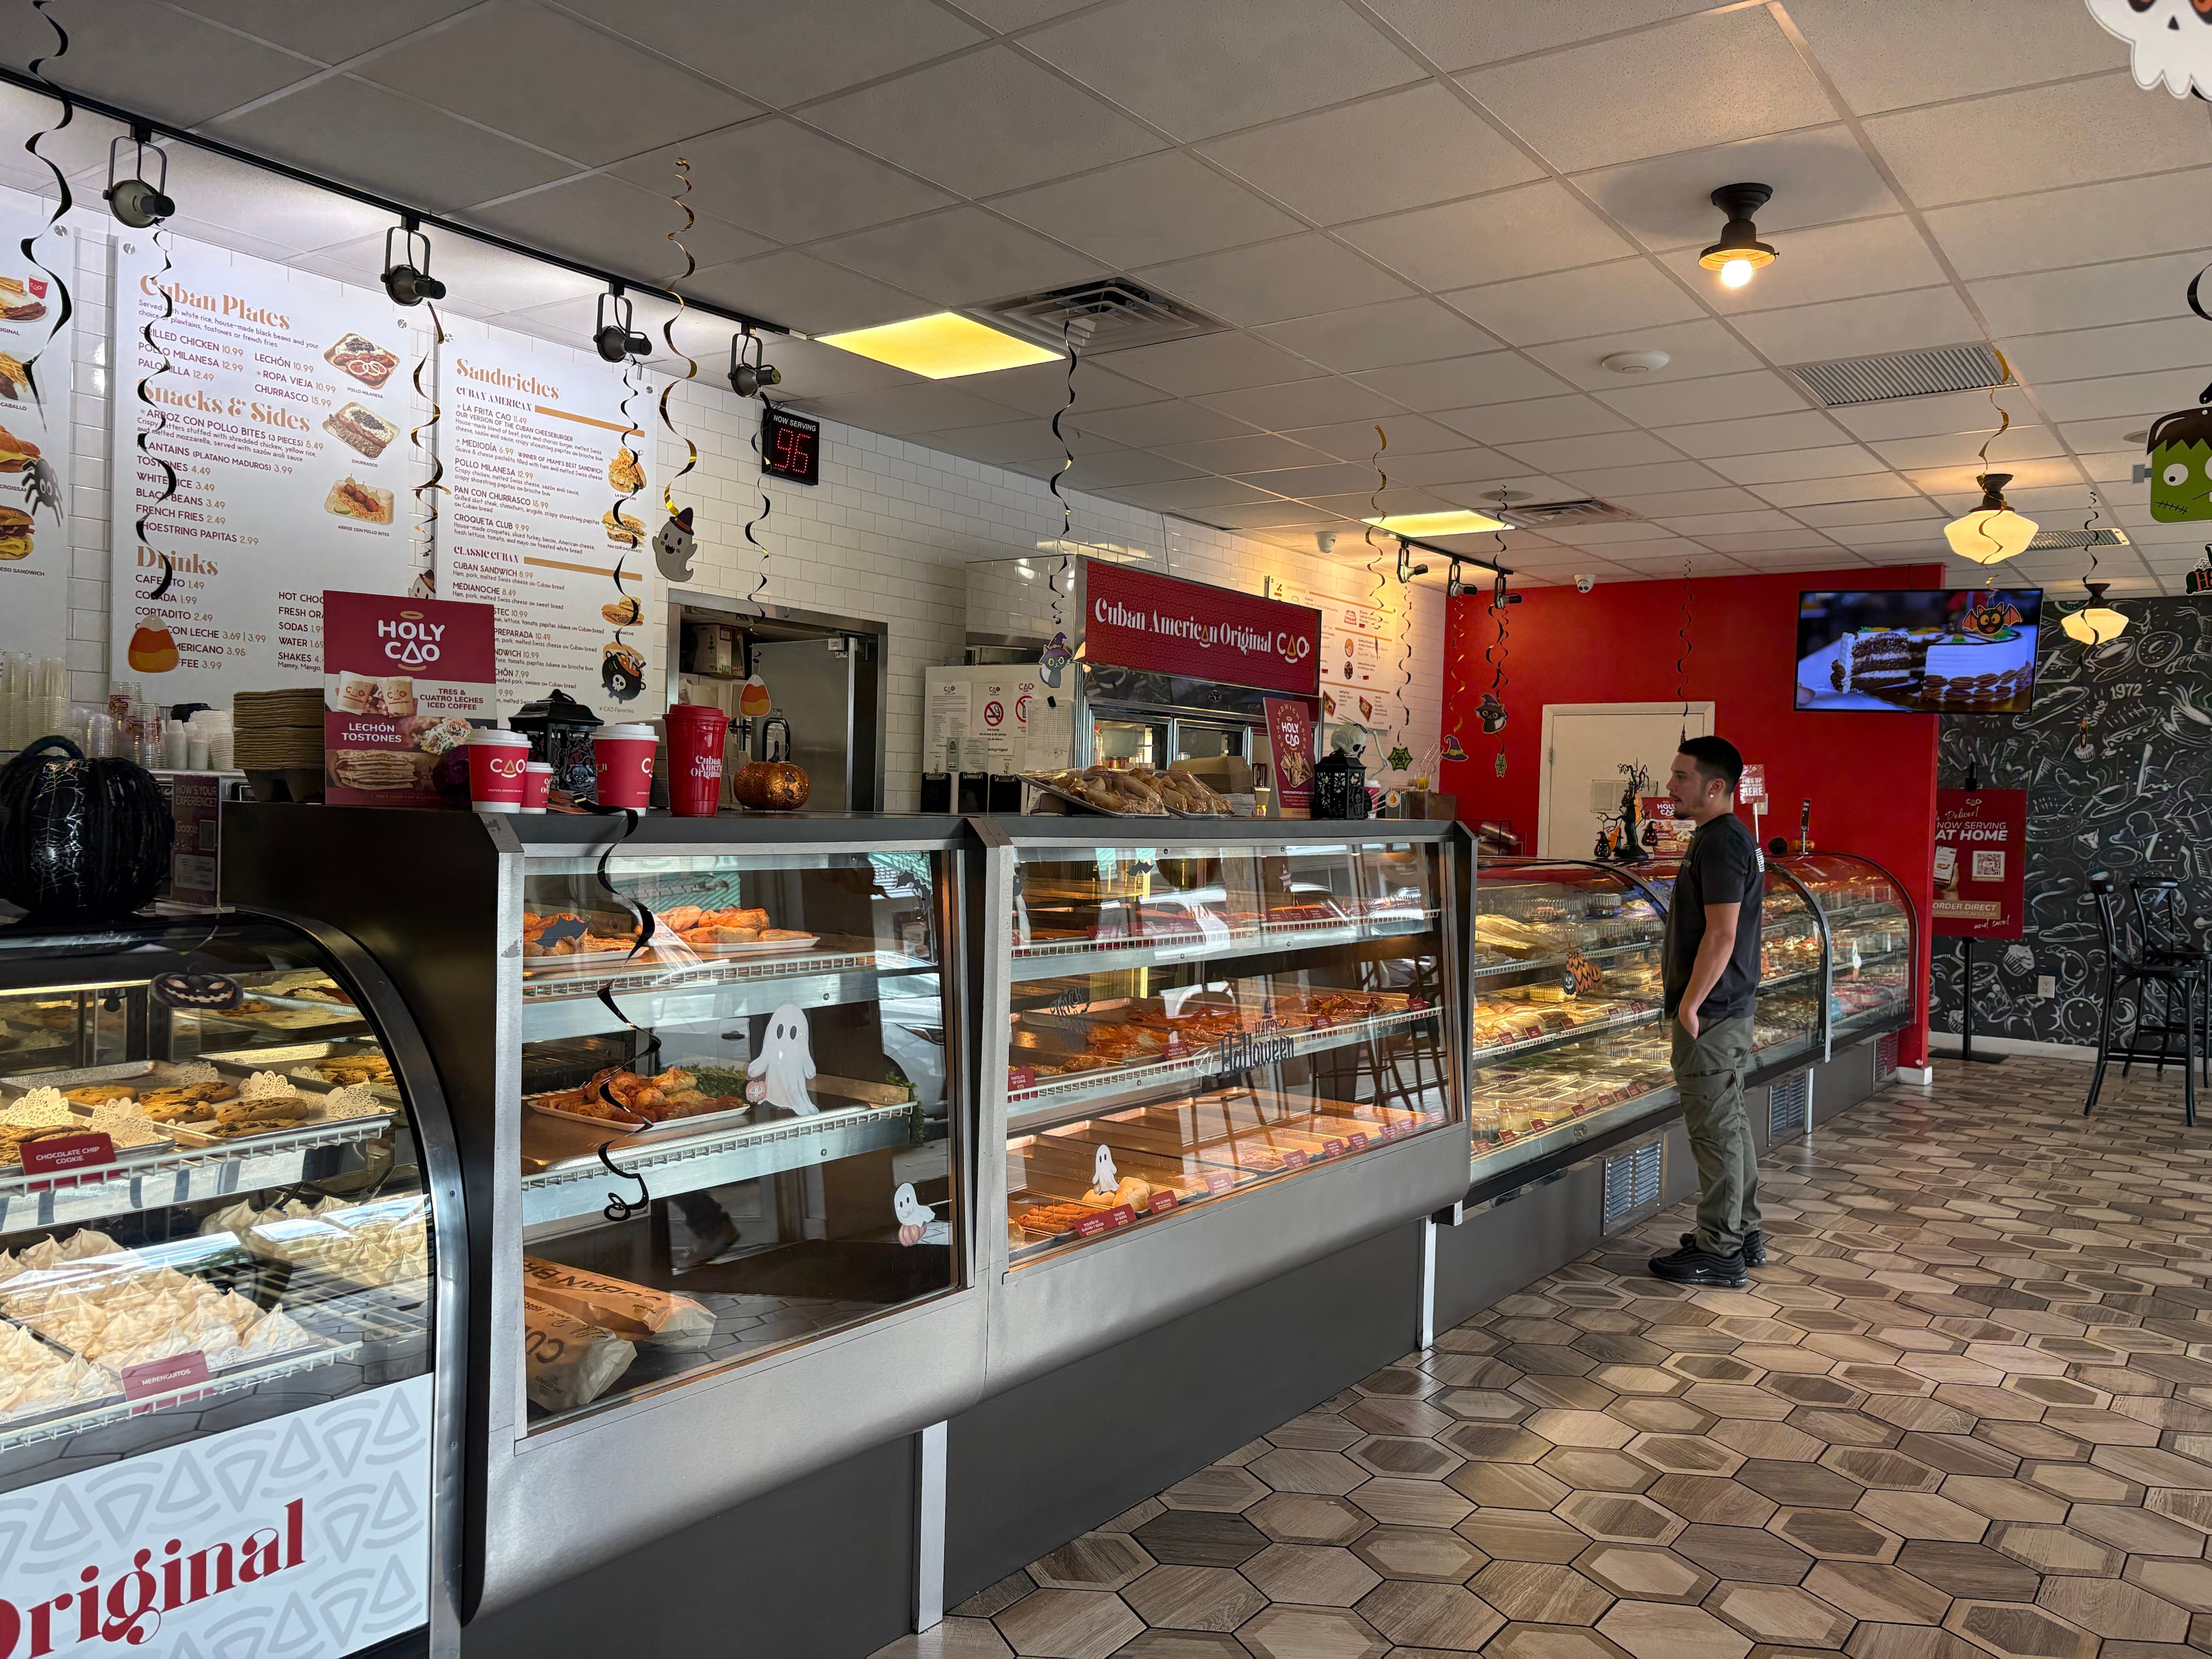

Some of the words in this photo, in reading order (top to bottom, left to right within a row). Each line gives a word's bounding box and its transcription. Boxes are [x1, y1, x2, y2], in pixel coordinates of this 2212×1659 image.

[140, 275, 216, 312] Cuban
[222, 294, 290, 330] Plates
[139, 300, 162, 311] Served
[181, 310, 199, 319] white
[256, 328, 272, 338] black
[274, 333, 291, 342] beans
[139, 310, 159, 319] choice
[243, 334, 262, 344] french
[264, 339, 278, 347] fries
[180, 336, 219, 351] CHICKEN
[222, 345, 243, 357] 10.99
[173, 350, 219, 368] MILANESA
[222, 361, 243, 372] 12.99
[255, 353, 290, 368] LECHÓN
[294, 362, 314, 373] 10.99
[193, 370, 214, 381] 12.49
[263, 370, 287, 383] ROPA
[290, 376, 313, 389] VIEJA
[316, 382, 336, 393] 10.99
[457, 358, 559, 400] Sandwiches
[255, 384, 308, 402] CHURRASCO
[311, 396, 331, 407] 15.99
[456, 386, 486, 401] CUBAN
[488, 395, 532, 412] AMERICAN
[1, 402, 27, 411] CABALLO
[463, 403, 472, 412] LA
[474, 407, 493, 418] FRITA
[496, 412, 511, 421] CAO
[514, 415, 527, 425] 11.49
[251, 402, 310, 432] Sides
[470, 414, 493, 424] VERSION
[515, 424, 533, 433] CUBAN
[773, 415, 789, 425] NOW
[789, 419, 816, 432] SERVING
[137, 417, 158, 427] Crispy
[229, 436, 258, 446] shredded
[183, 416, 204, 428] CON
[207, 421, 238, 434] POLLO
[241, 428, 266, 439] BITES
[278, 436, 303, 447] PIECES)
[306, 440, 324, 451] 5.49
[214, 440, 235, 449] served
[775, 428, 810, 473] 96
[352, 459, 378, 468] CHURRASCO
[462, 438, 497, 452] MEDIODÍA
[499, 447, 514, 455] 6.99
[578, 464, 603, 475] SANDWICH
[192, 465, 211, 475] 4.49
[274, 464, 292, 474] 3.99
[455, 458, 479, 469] POLLO
[481, 463, 515, 476] MILANESA
[517, 470, 533, 480] 12.99
[137, 471, 168, 485] WHITE
[195, 481, 215, 492] 3.49
[171, 494, 203, 506] BEANS
[206, 499, 226, 510] 3.49
[454, 485, 469, 494] PAN
[471, 489, 487, 498] CON
[489, 492, 531, 505] CHURRASCO
[533, 500, 549, 509] 15.99
[136, 504, 175, 518] FRENCH
[178, 511, 204, 522] FRIES
[207, 515, 226, 525] 2.49
[454, 513, 493, 526] CROQUETA
[496, 520, 513, 530] CLUB
[515, 524, 529, 532] 9.99
[200, 530, 237, 543] PAPITAS
[240, 536, 258, 545] 2.99
[136, 545, 218, 576] Drinks
[491, 552, 519, 563] CUBAN
[13, 568, 45, 576] SANDWICH
[453, 561, 478, 571] CUBAN
[480, 565, 517, 576] SANDWICH
[519, 571, 533, 579] 8.99
[188, 580, 205, 590] 1.49
[453, 582, 500, 595] MEDIANOCHE
[181, 595, 198, 605] 1.99
[279, 592, 297, 601] HOT
[136, 607, 191, 620] CORTADITO
[194, 612, 213, 622] 2.49
[279, 606, 306, 617] FRESH
[511, 609, 528, 618] 10.99
[279, 622, 308, 632] SODAS
[378, 620, 446, 642] HOLY
[1095, 597, 1146, 631] Cuban
[1149, 609, 1218, 648] American
[1220, 622, 1271, 656] Original
[1276, 632, 1310, 663] CAO
[190, 627, 219, 638] LECHE
[222, 631, 241, 640] 3.69
[247, 633, 266, 643] 3.99
[279, 637, 307, 647] WATER
[536, 633, 551, 641] 10.49
[227, 647, 246, 656] 3.95
[278, 652, 312, 662] SHAKES
[385, 640, 440, 664] CAO
[523, 651, 539, 659] 10.99
[202, 661, 222, 670] 3.99
[498, 689, 513, 697] 9.99
[1018, 683, 1034, 692] CAO
[2110, 683, 2144, 700] 1972
[420, 694, 453, 702] CUATRO
[454, 695, 484, 704] LECHES
[348, 722, 395, 733] LECHÓN
[1281, 722, 1299, 734] HOLY
[341, 732, 402, 743] TOSTONES
[1285, 733, 1299, 746] CAO
[695, 755, 722, 765] Cuban
[489, 758, 526, 778] CAO
[199, 786, 217, 796] YOUR
[1742, 787, 1763, 796] HERE
[176, 820, 198, 836] Google
[1935, 829, 1957, 841] AT
[1960, 830, 2008, 841] HOME
[1255, 1018, 1279, 1038] HAPPY
[1219, 1031, 1294, 1077] Halloween
[36, 1149, 81, 1161] CHOCOLATE
[55, 1156, 84, 1165] COOKIE
[142, 1368, 191, 1386] MERENGUITOS
